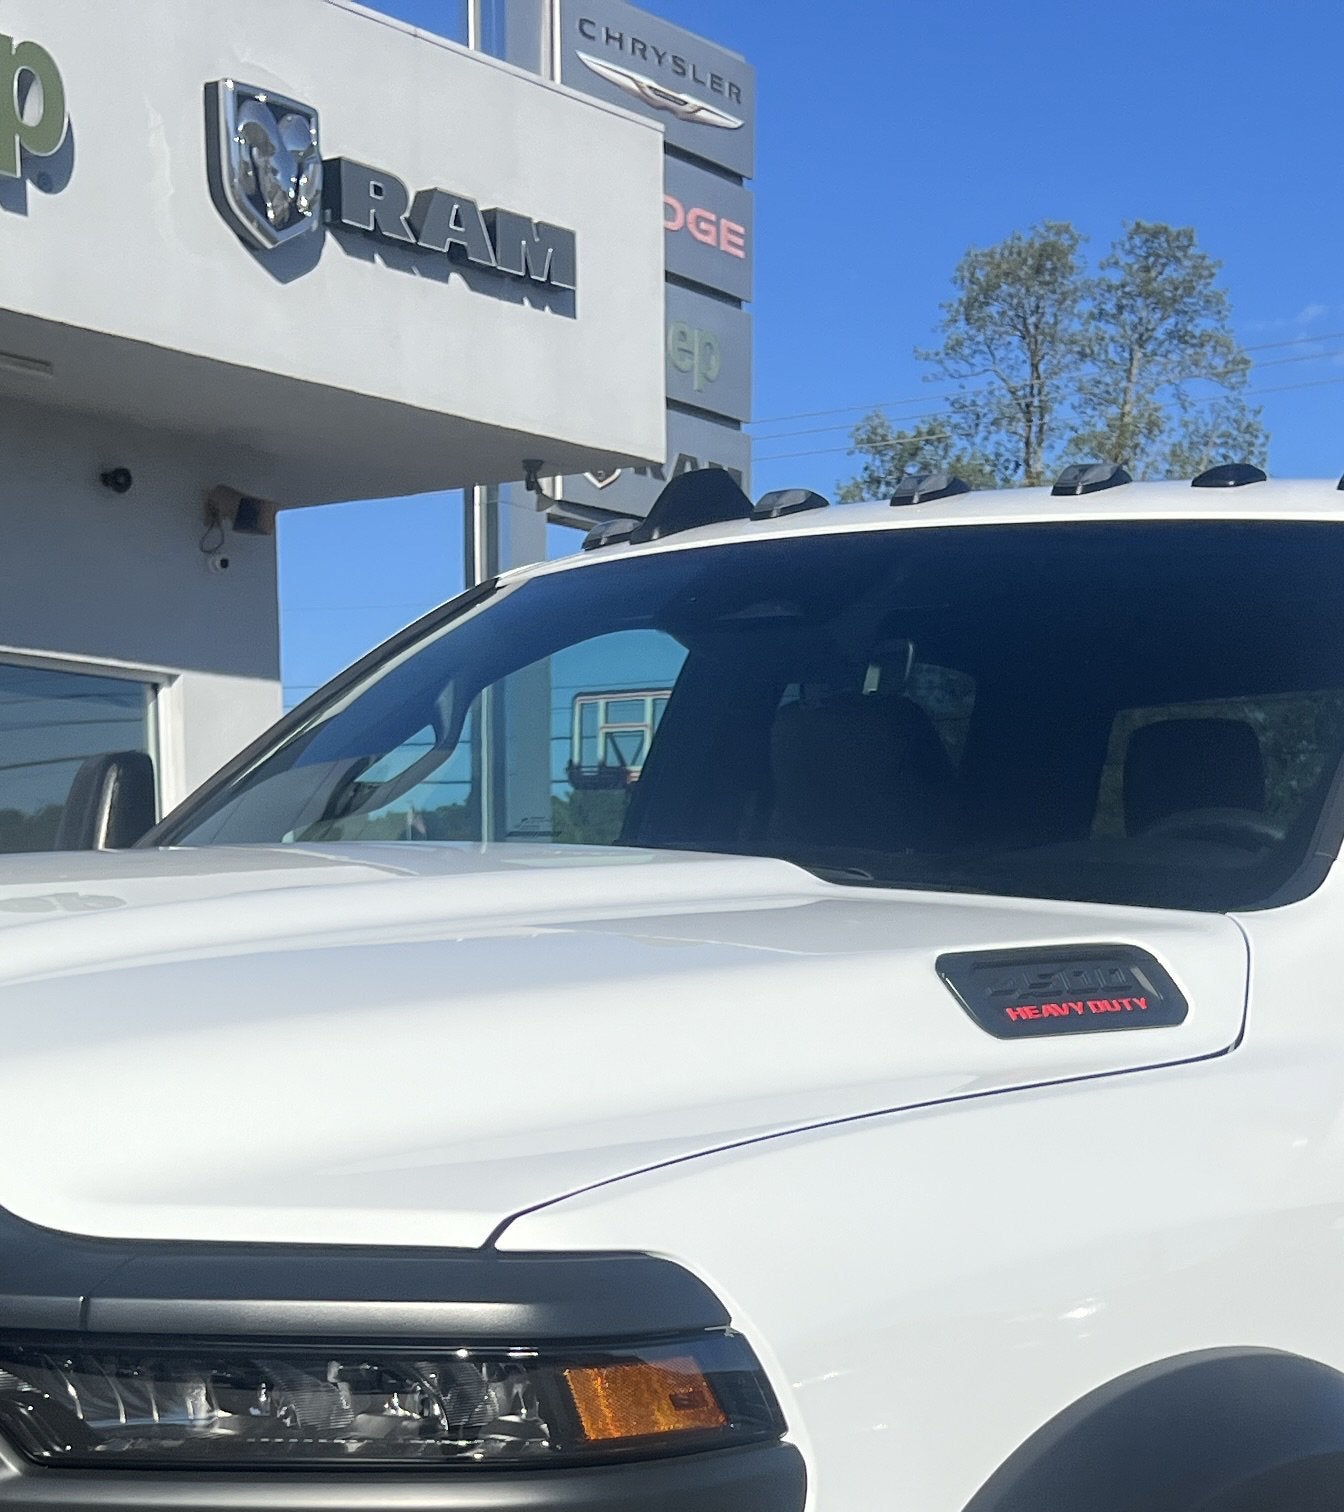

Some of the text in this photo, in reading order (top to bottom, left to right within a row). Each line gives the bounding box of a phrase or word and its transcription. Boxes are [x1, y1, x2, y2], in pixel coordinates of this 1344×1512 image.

[577, 17, 742, 105] CHRYSLER
[323, 156, 578, 290] RAM
[1005, 997, 1148, 1022] HEAVY DUTY
